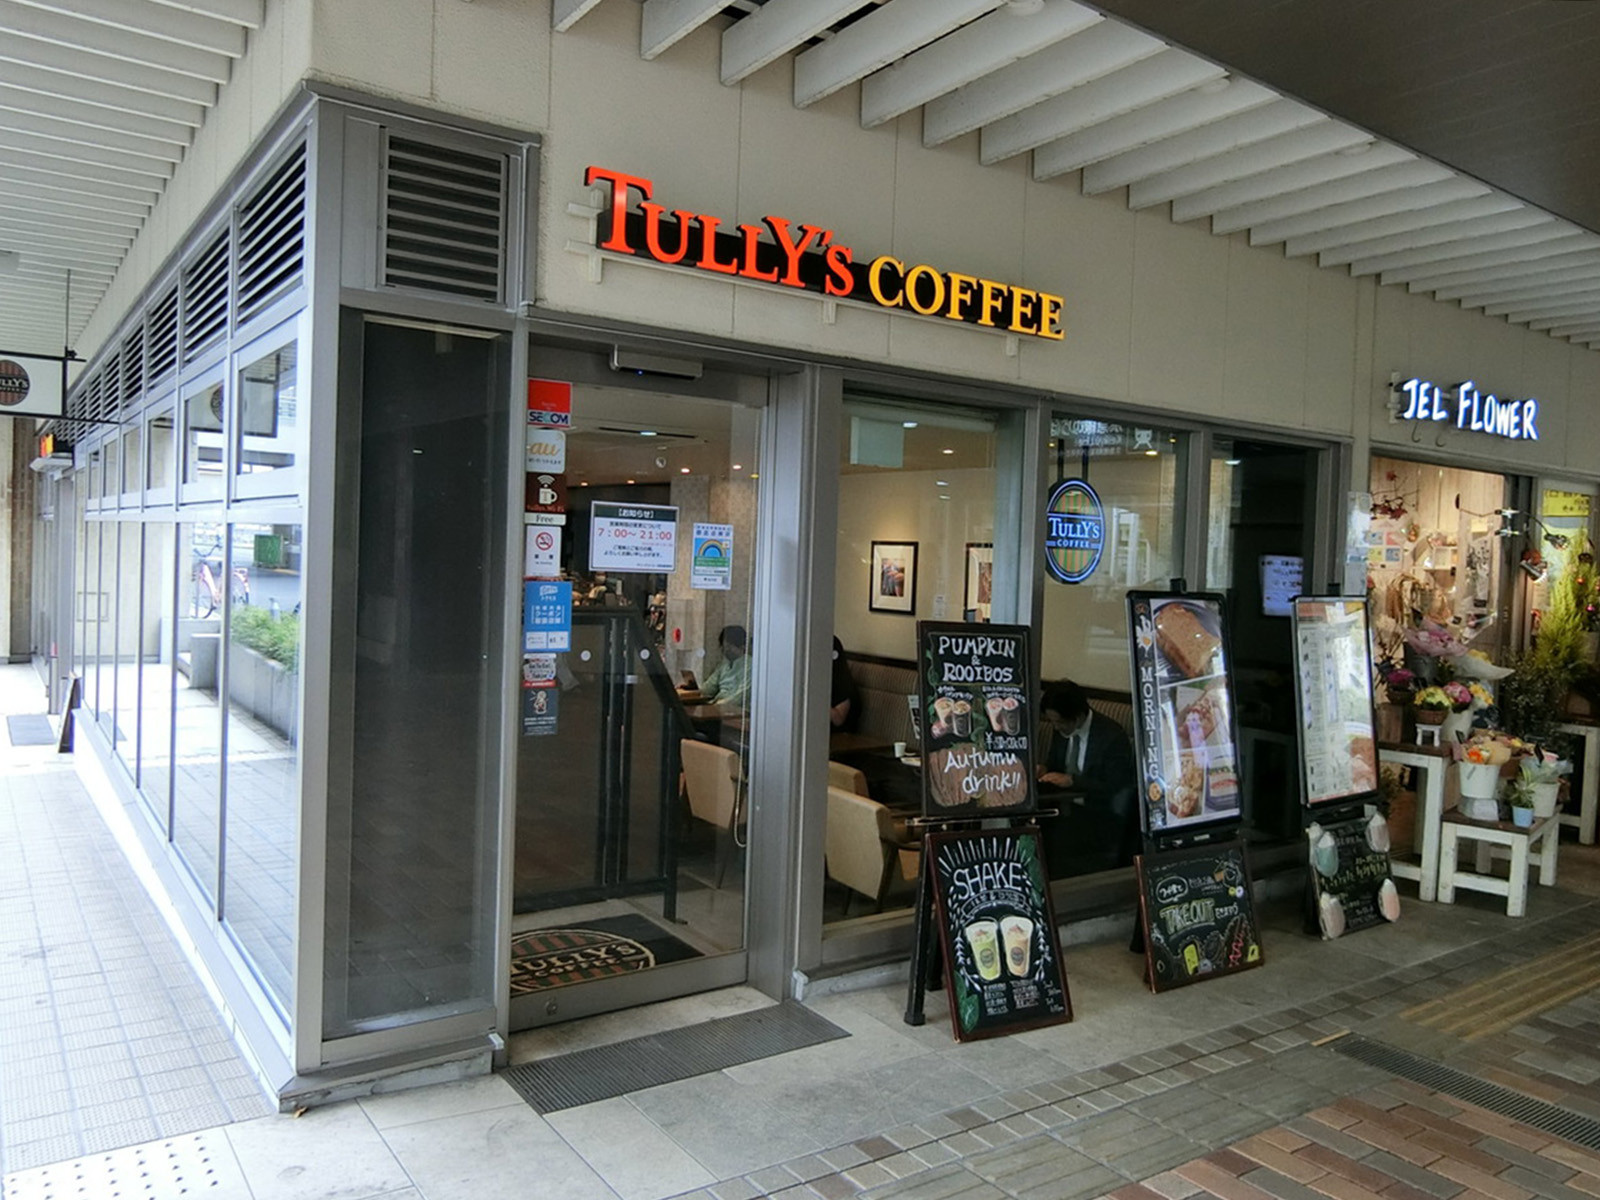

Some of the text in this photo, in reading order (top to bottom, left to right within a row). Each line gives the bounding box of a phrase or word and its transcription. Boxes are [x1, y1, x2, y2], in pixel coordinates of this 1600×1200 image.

[586, 166, 1065, 340] TULLY'S COFFEE
[528, 411, 569, 425] SECOM
[1402, 378, 1539, 440] JEL FLOWER
[535, 514, 554, 523] Free
[1048, 517, 1100, 539] TULLY'S
[1057, 539, 1091, 548] COFFEE
[938, 635, 1016, 658] PUMPKIN
[971, 655, 981, 666] &
[942, 662, 1014, 682] ROOIBOS
[1141, 666, 1160, 779] MORNING
[962, 770, 1021, 794] drink!!
[952, 861, 1024, 900] SHAKE
